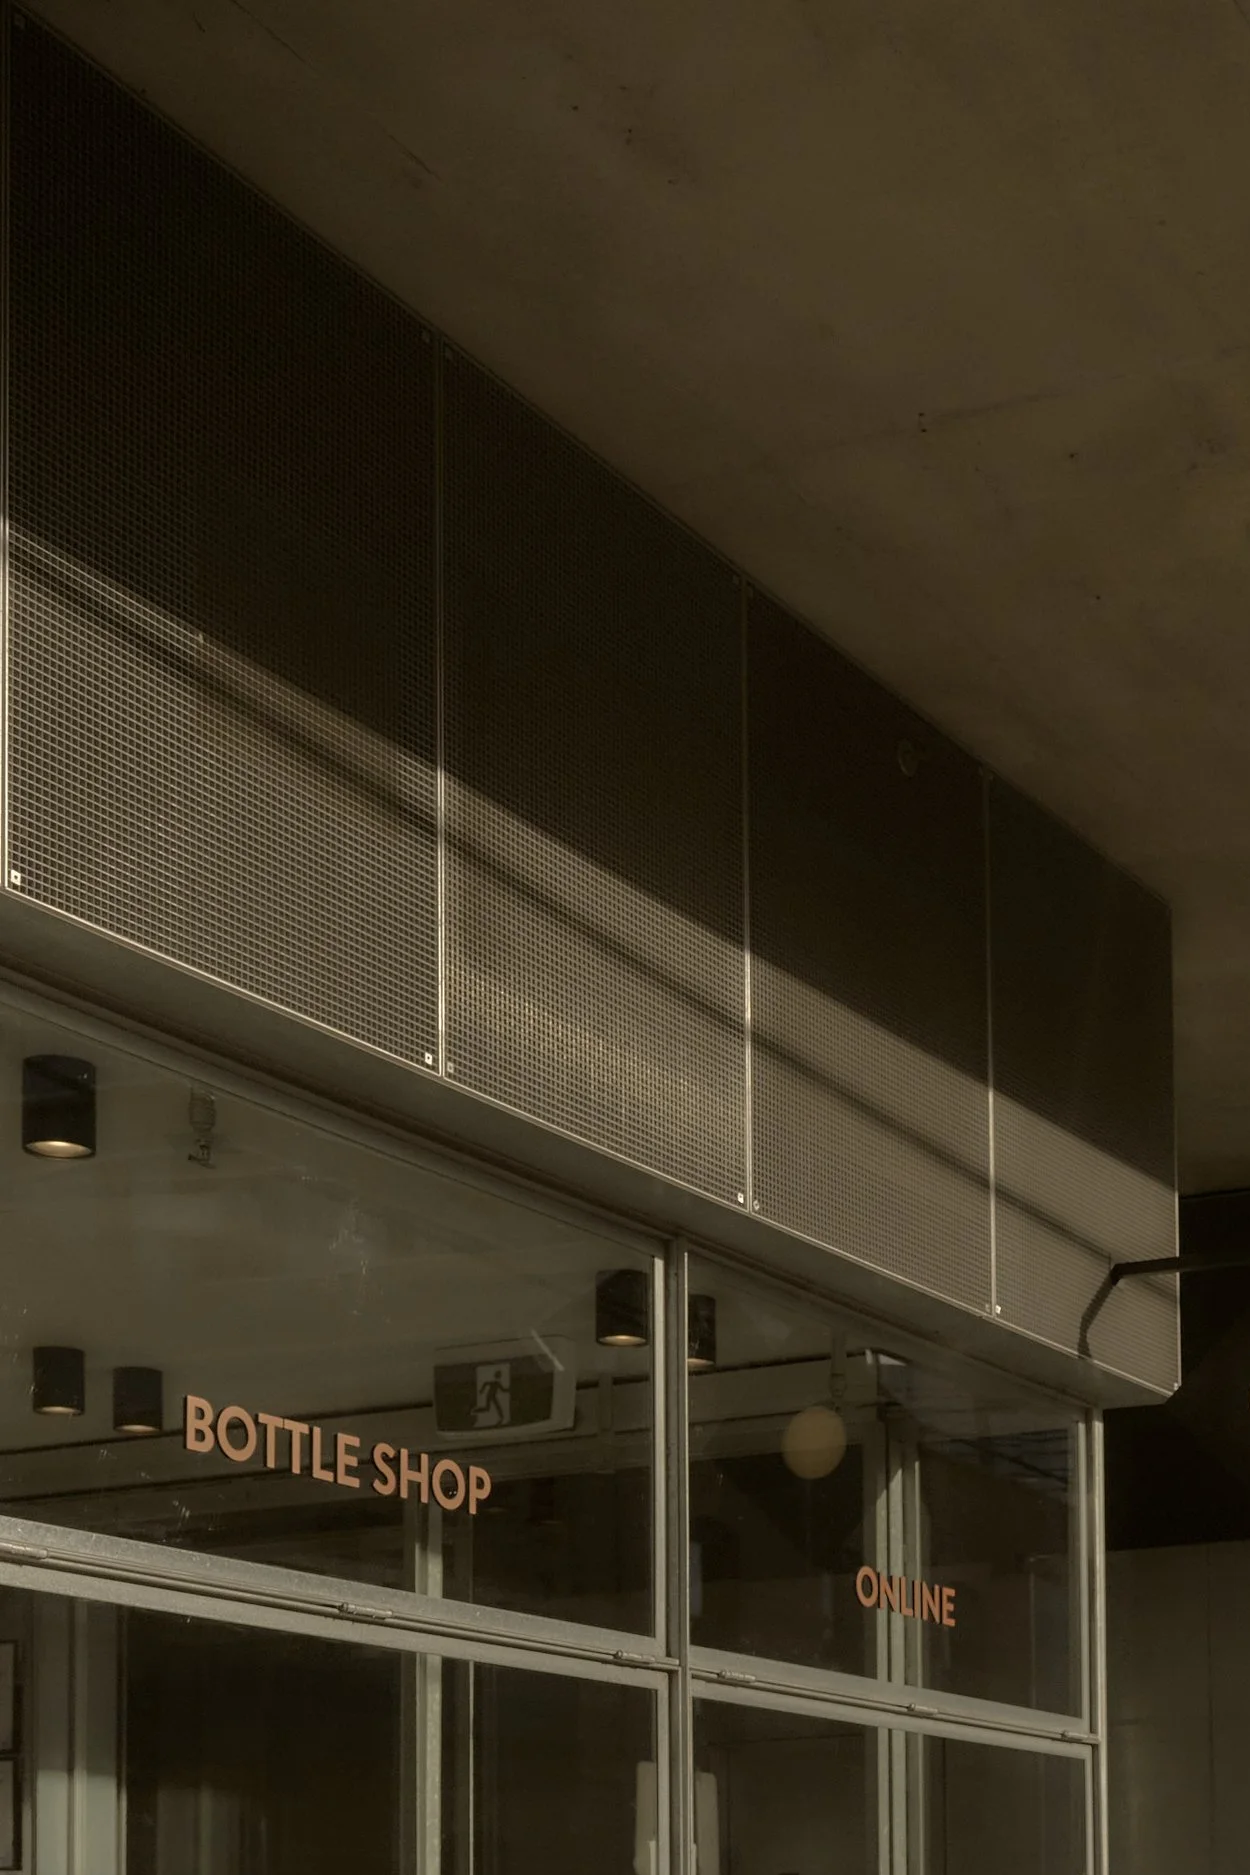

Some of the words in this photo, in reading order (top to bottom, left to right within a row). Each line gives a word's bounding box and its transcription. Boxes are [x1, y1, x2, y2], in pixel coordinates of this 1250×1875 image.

[184, 1394, 361, 1489] BOTTLE
[371, 1441, 493, 1516] SHOP
[855, 1565, 957, 1628] ONLINE
